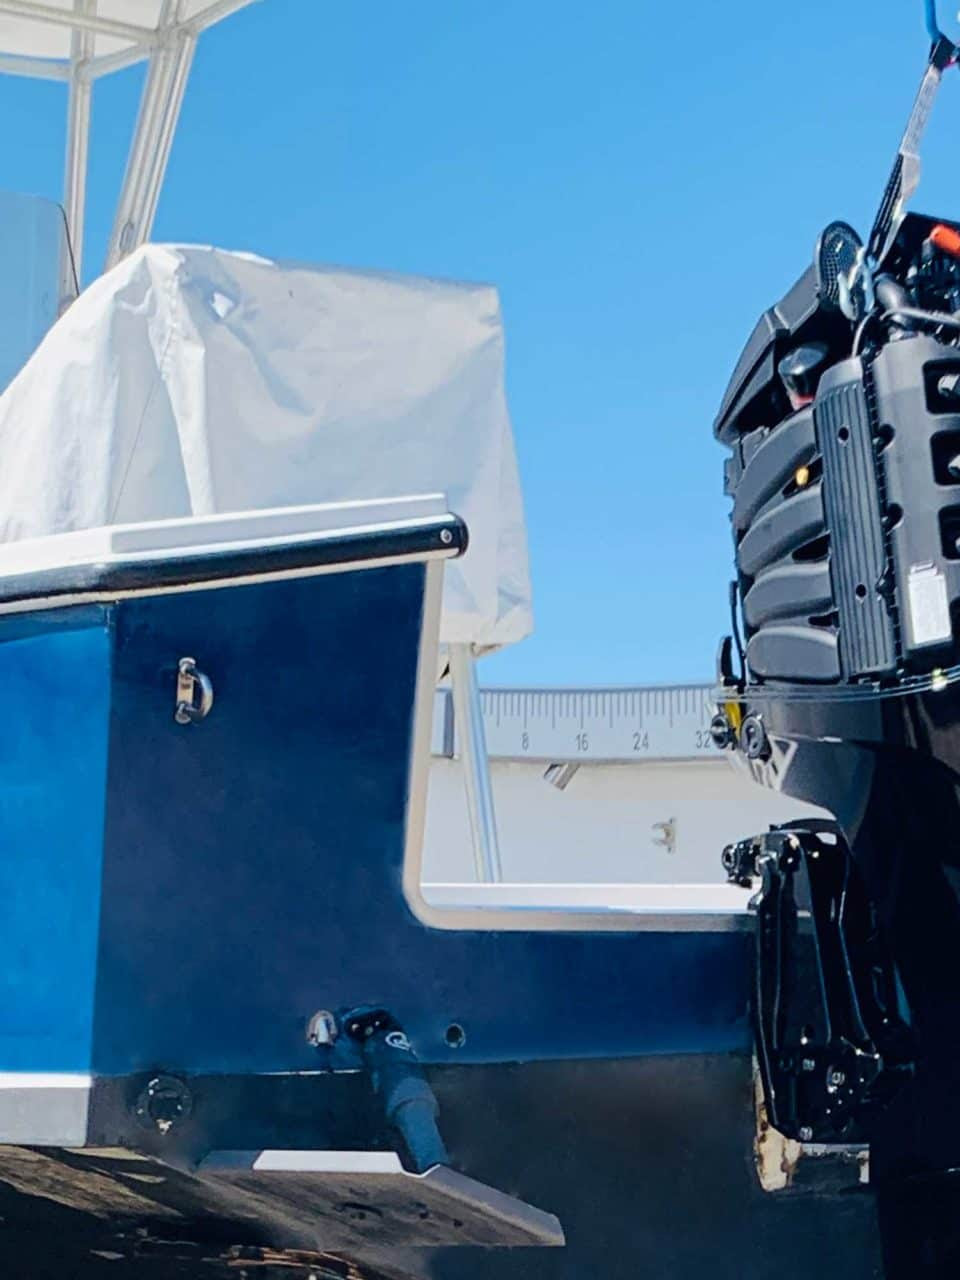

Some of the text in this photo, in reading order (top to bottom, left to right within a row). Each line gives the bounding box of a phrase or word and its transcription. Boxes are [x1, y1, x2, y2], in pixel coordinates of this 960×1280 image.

[521, 730, 711, 751] 8 16 24 32
